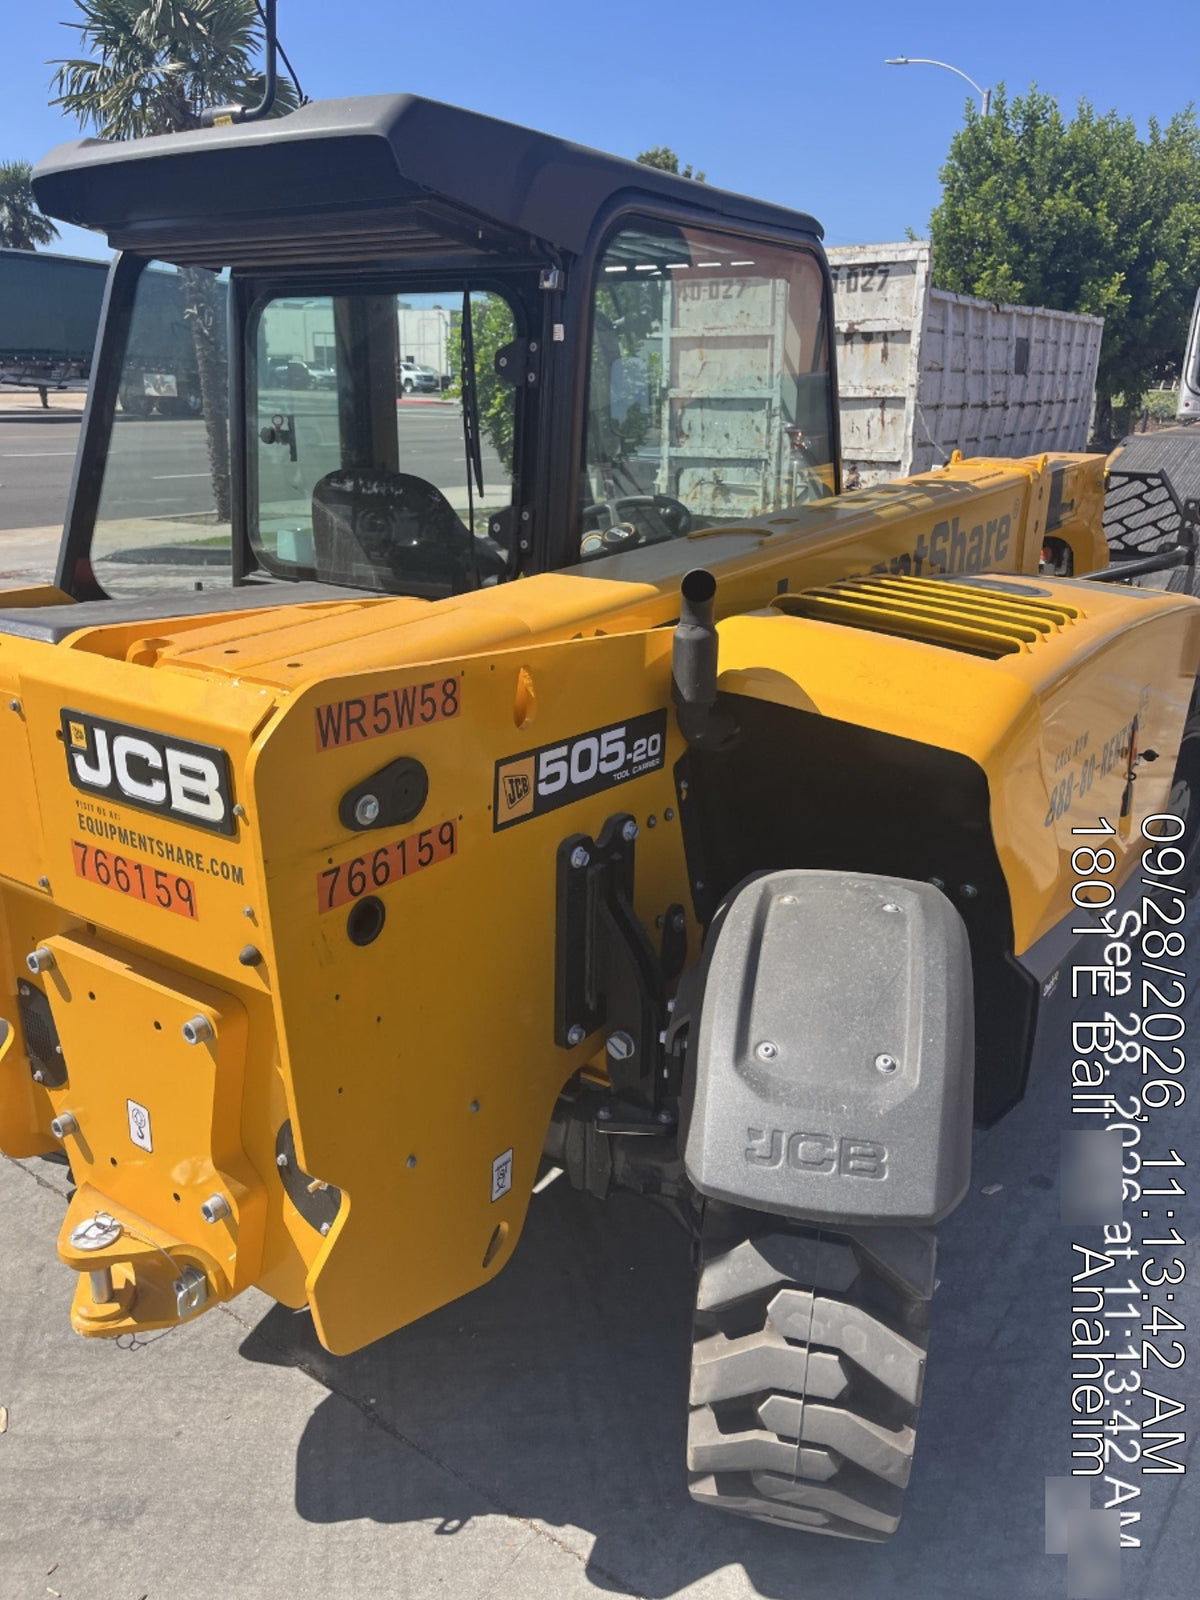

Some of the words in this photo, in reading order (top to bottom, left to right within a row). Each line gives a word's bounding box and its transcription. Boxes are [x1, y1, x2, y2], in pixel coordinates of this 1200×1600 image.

[316, 678, 458, 748] WR5W58
[72, 727, 225, 824] JCB
[506, 776, 530, 805] JCB
[74, 841, 194, 917] 766159
[78, 812, 245, 886] EQUIPMENTSHARE.COM
[322, 821, 455, 908] 766159
[744, 1127, 889, 1182] JCB
